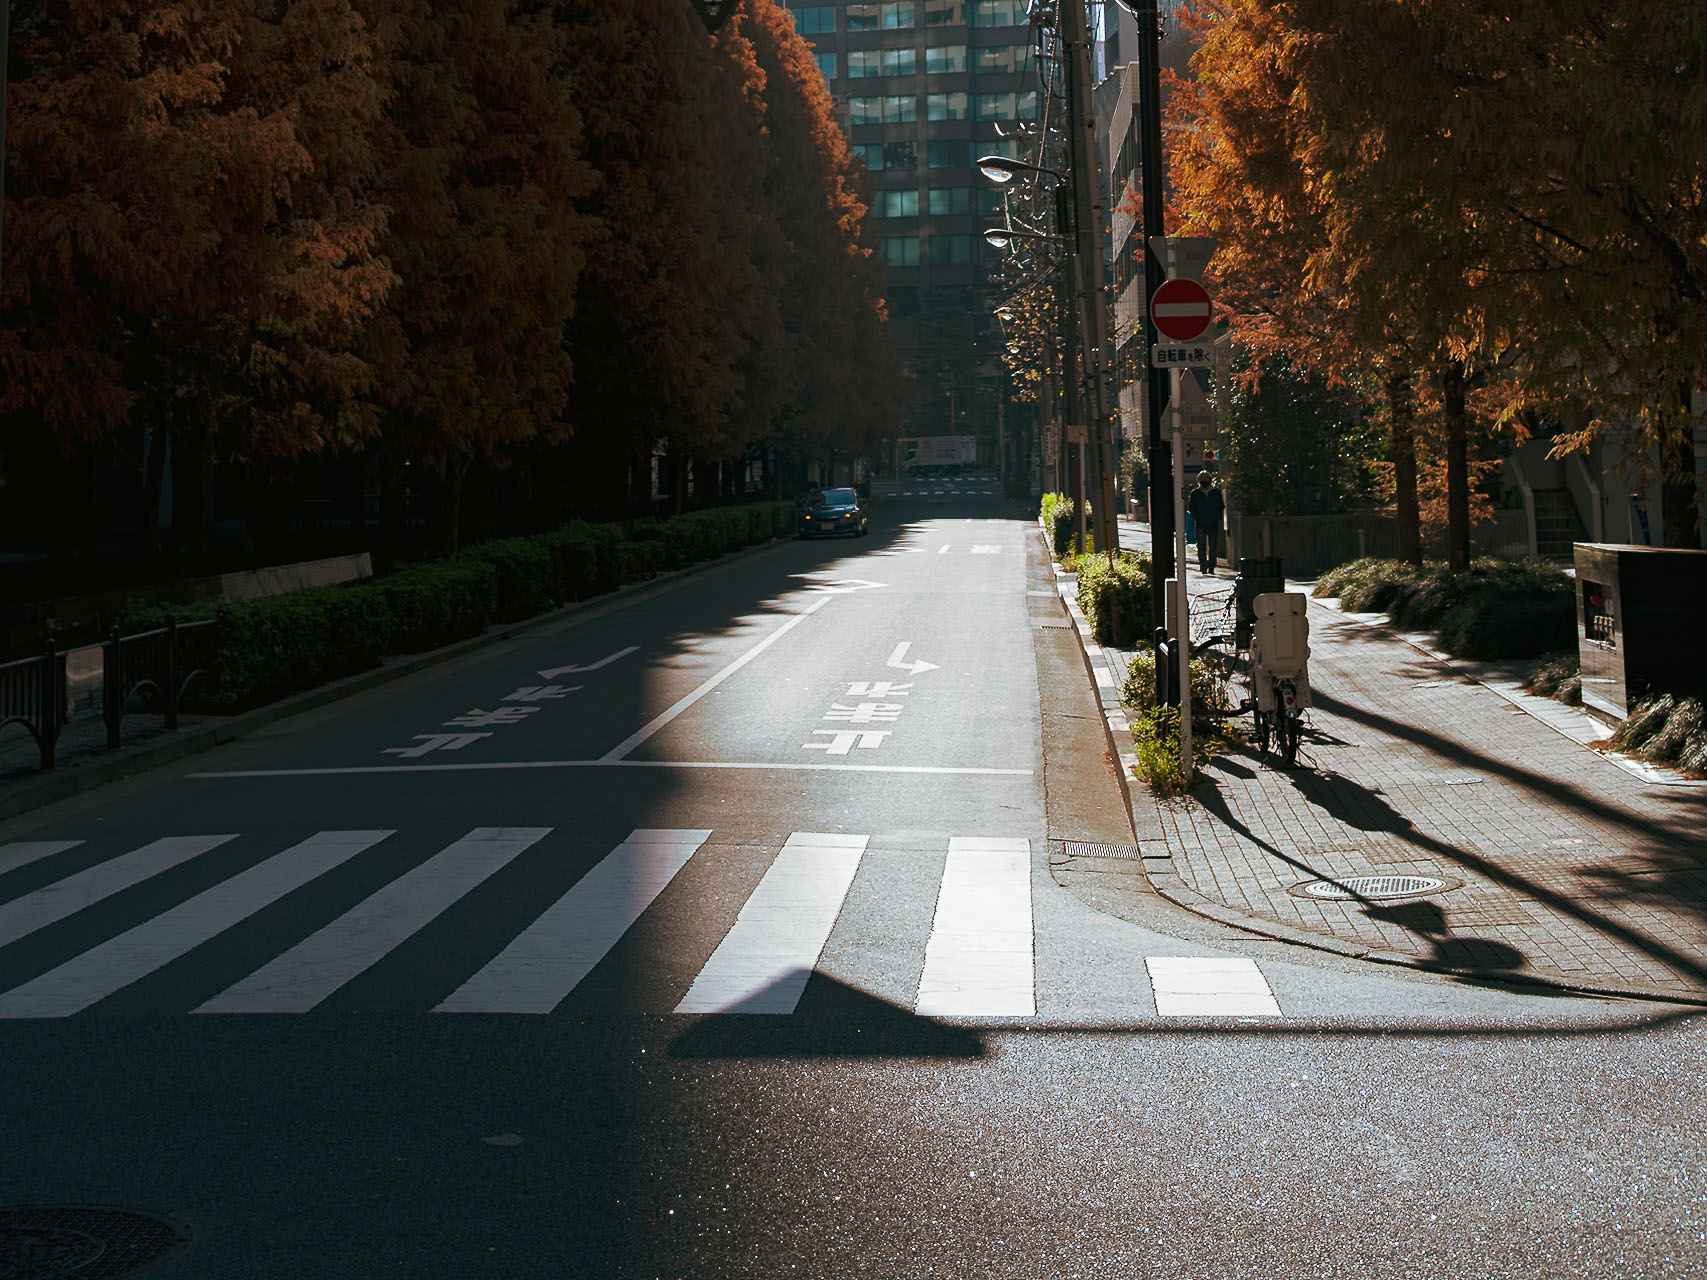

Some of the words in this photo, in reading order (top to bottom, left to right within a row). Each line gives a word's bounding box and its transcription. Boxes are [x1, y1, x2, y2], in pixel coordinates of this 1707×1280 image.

[1157, 348, 1210, 363] 自転車を除く
[383, 685, 584, 758] 止まれ
[801, 681, 914, 755] 止まれ
